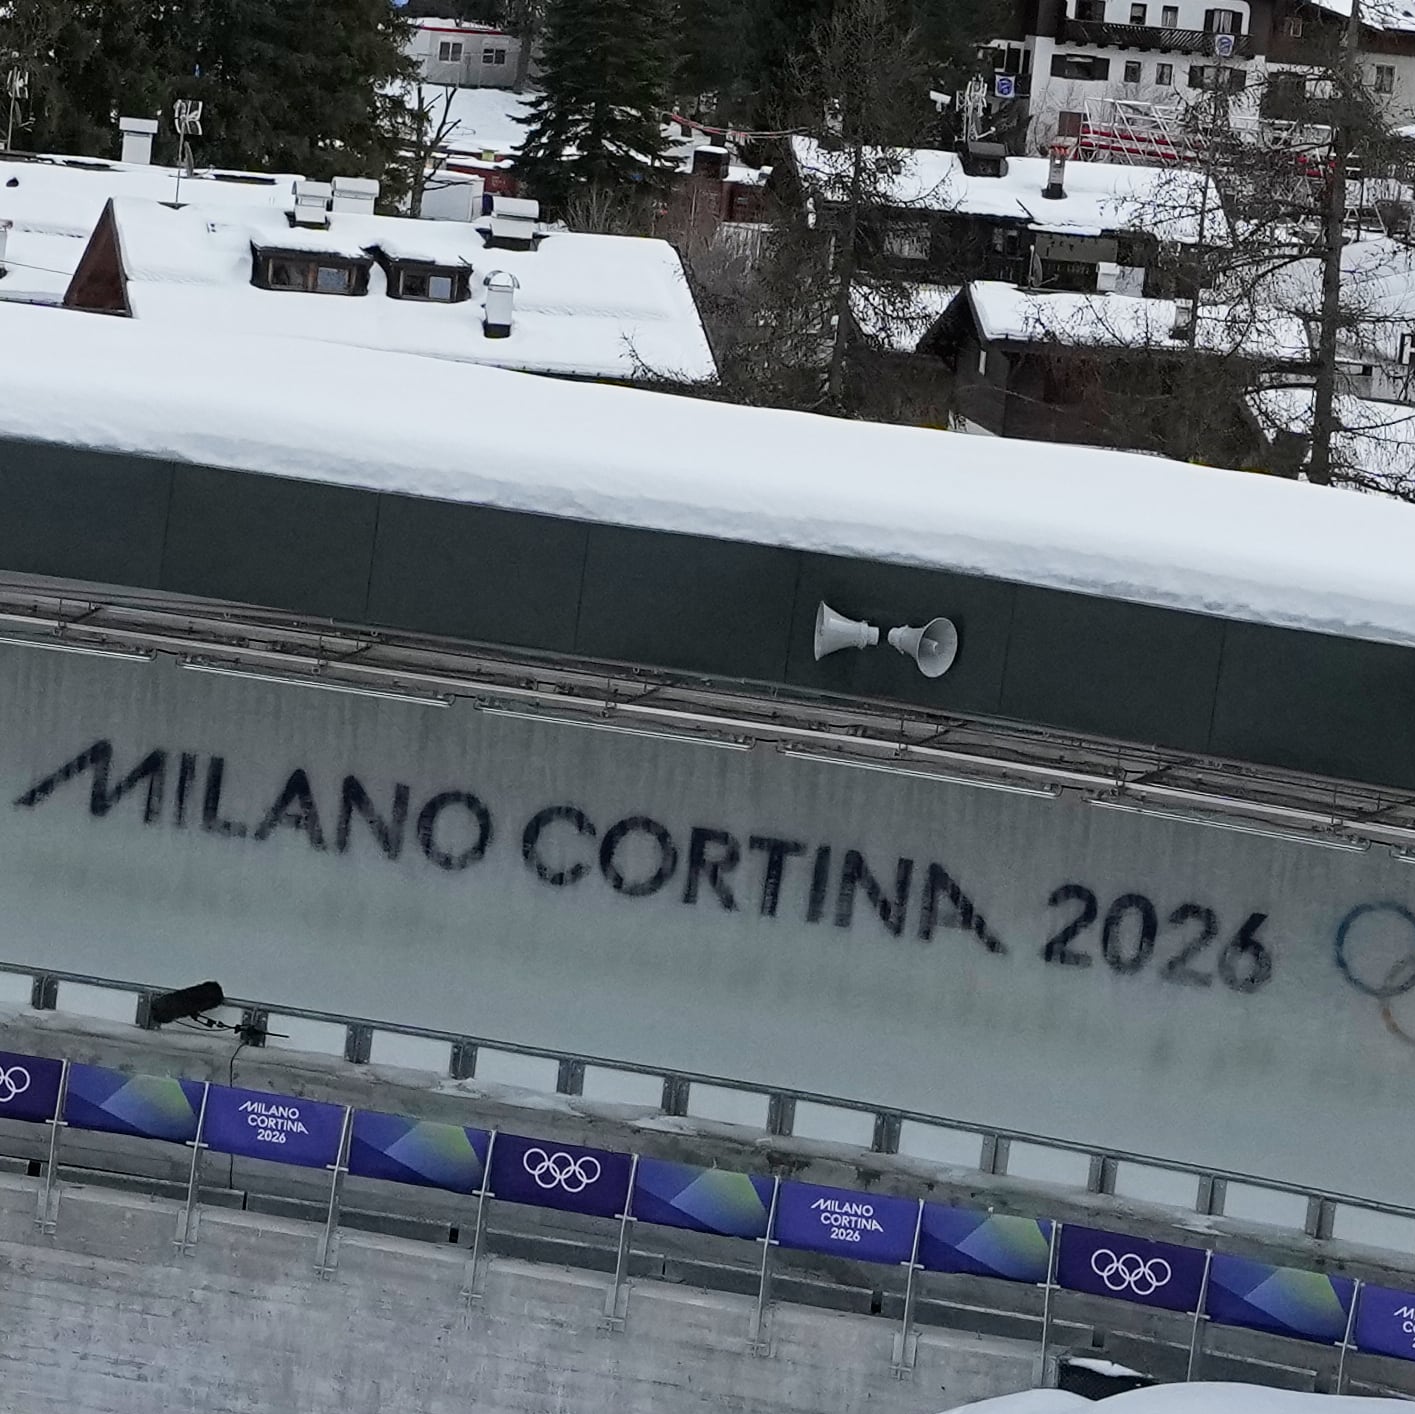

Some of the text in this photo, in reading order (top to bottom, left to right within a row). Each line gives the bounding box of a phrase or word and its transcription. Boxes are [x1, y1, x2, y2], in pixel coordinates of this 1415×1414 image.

[13, 738, 1275, 994] MILANO CORTINA 2026
[239, 1101, 300, 1119] MILANO
[248, 1114, 309, 1135] CORTINA
[257, 1129, 287, 1144] 2026
[811, 1198, 874, 1217] MILANO
[820, 1212, 884, 1232] CORTINA
[830, 1227, 861, 1242] 2026
